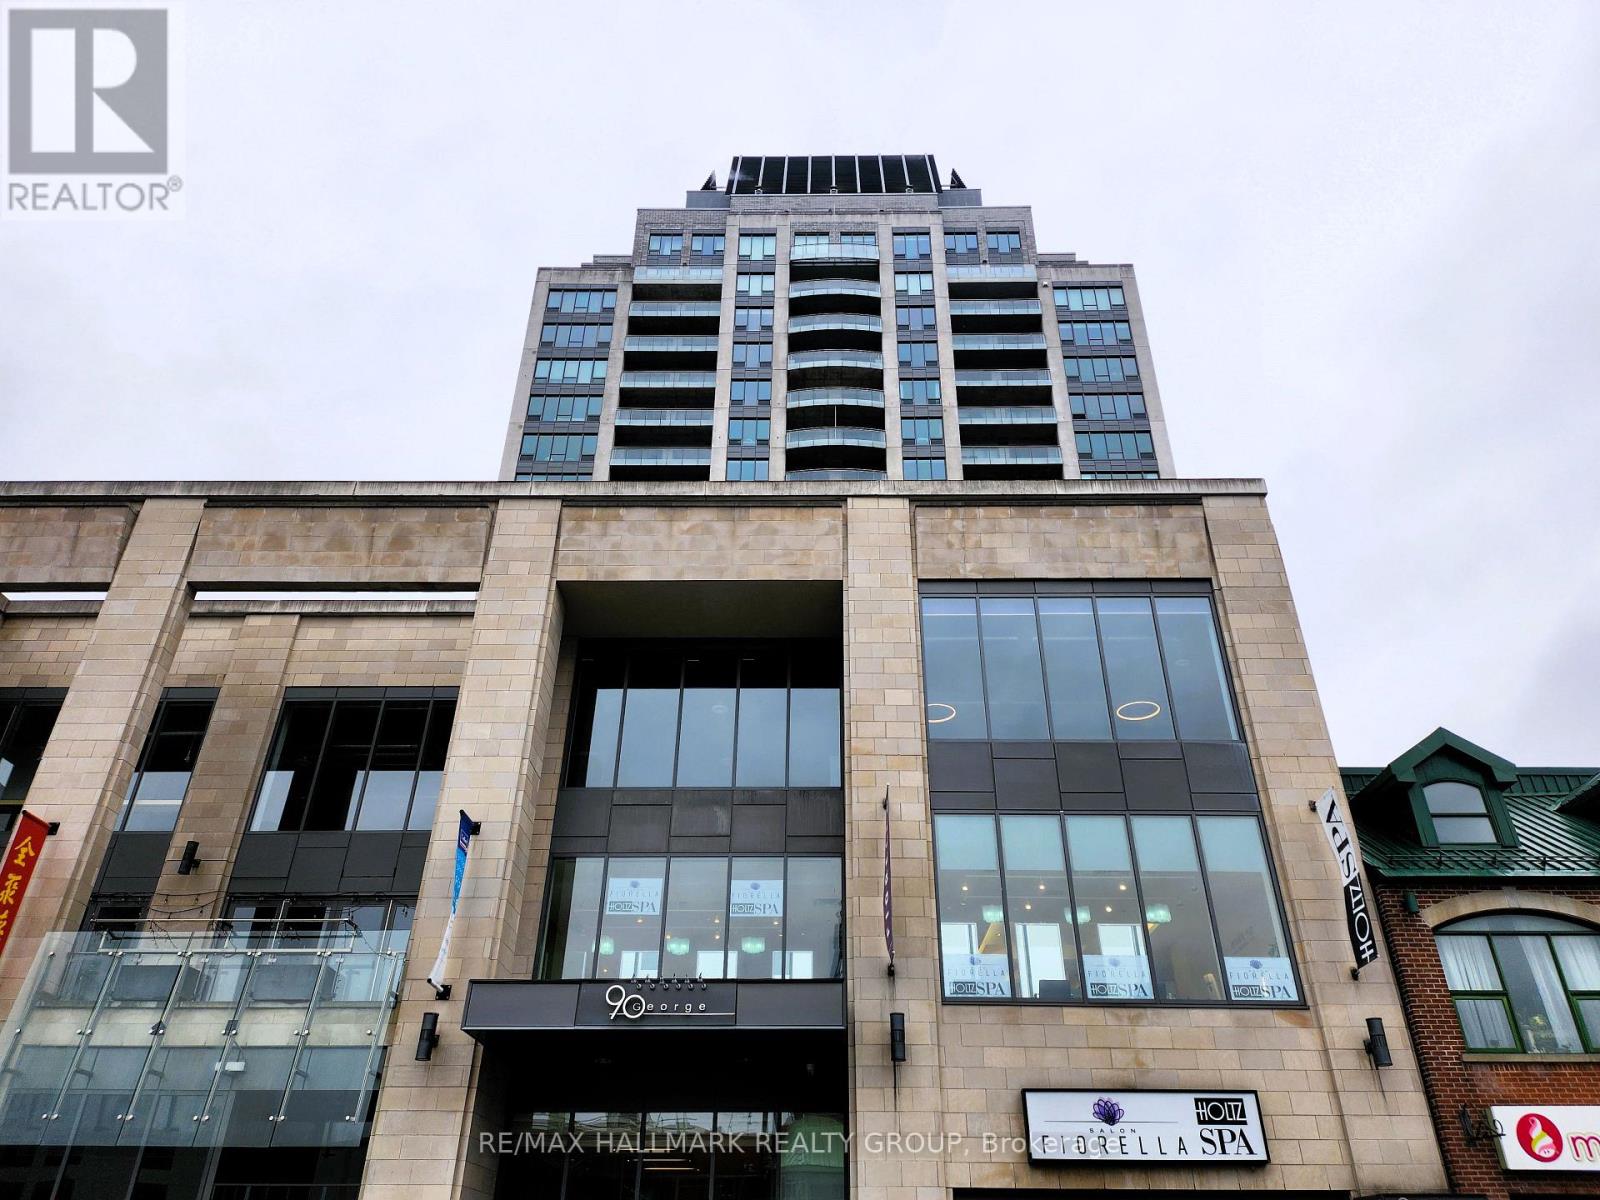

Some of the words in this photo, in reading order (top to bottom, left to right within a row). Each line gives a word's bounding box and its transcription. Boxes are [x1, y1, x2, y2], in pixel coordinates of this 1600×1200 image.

[1326, 799, 1357, 879] SPA
[632, 901, 656, 913] SPA
[754, 903, 779, 914] SPA
[1349, 880, 1374, 963] HOLTZ
[950, 981, 977, 995] HOLTZ
[977, 981, 1006, 996] SPA
[1090, 982, 1119, 997] HOLTZ
[1119, 983, 1149, 998] SPA
[1232, 984, 1262, 998] HOLTZ
[1260, 985, 1292, 999] SPA
[605, 984, 646, 1020] 90
[632, 1002, 706, 1013] George
[1195, 1100, 1248, 1122] HOLTZ
[1041, 1135, 1188, 1156] FIORELLA
[1199, 1127, 1258, 1156] SPA
